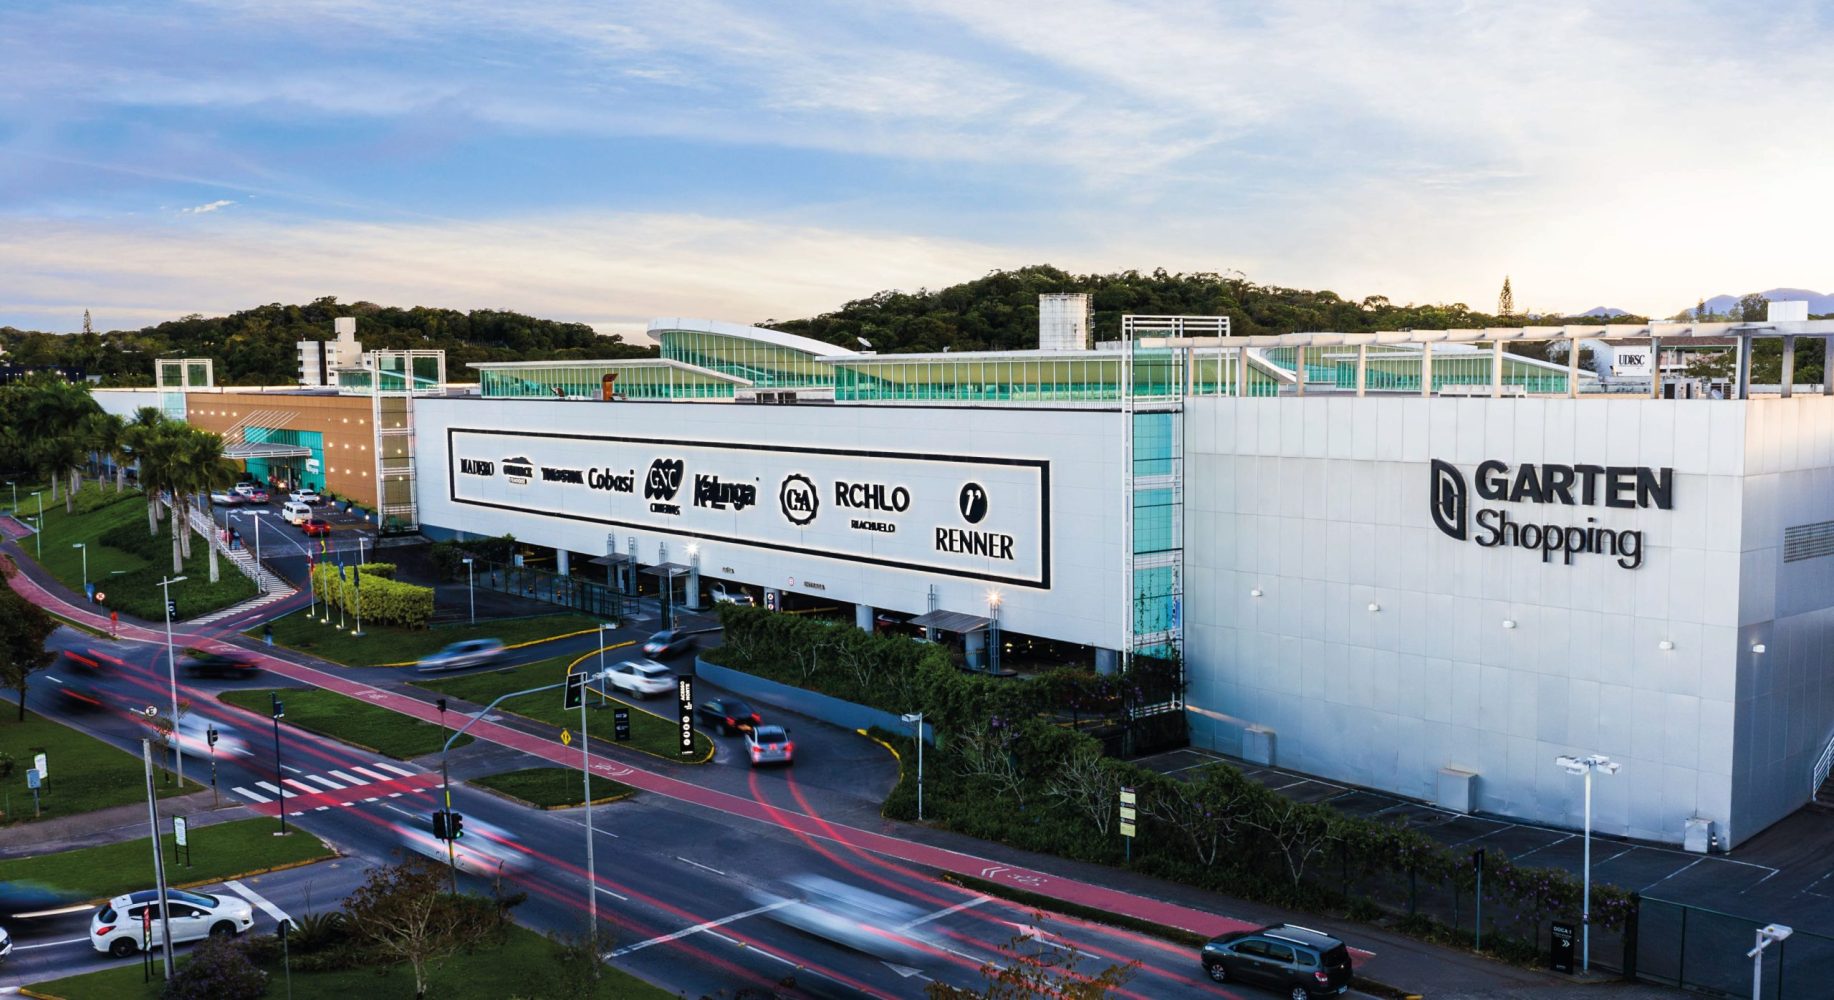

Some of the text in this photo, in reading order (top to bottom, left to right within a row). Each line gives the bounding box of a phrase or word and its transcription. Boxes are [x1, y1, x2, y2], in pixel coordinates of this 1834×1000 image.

[588, 467, 634, 493] Cobasi
[650, 467, 678, 491] GNC
[1474, 459, 1673, 510] GARTEN
[786, 488, 813, 512] C&A
[835, 481, 910, 512] RCHLO
[935, 527, 1014, 560] RENNER
[1474, 508, 1643, 569] Shopping
